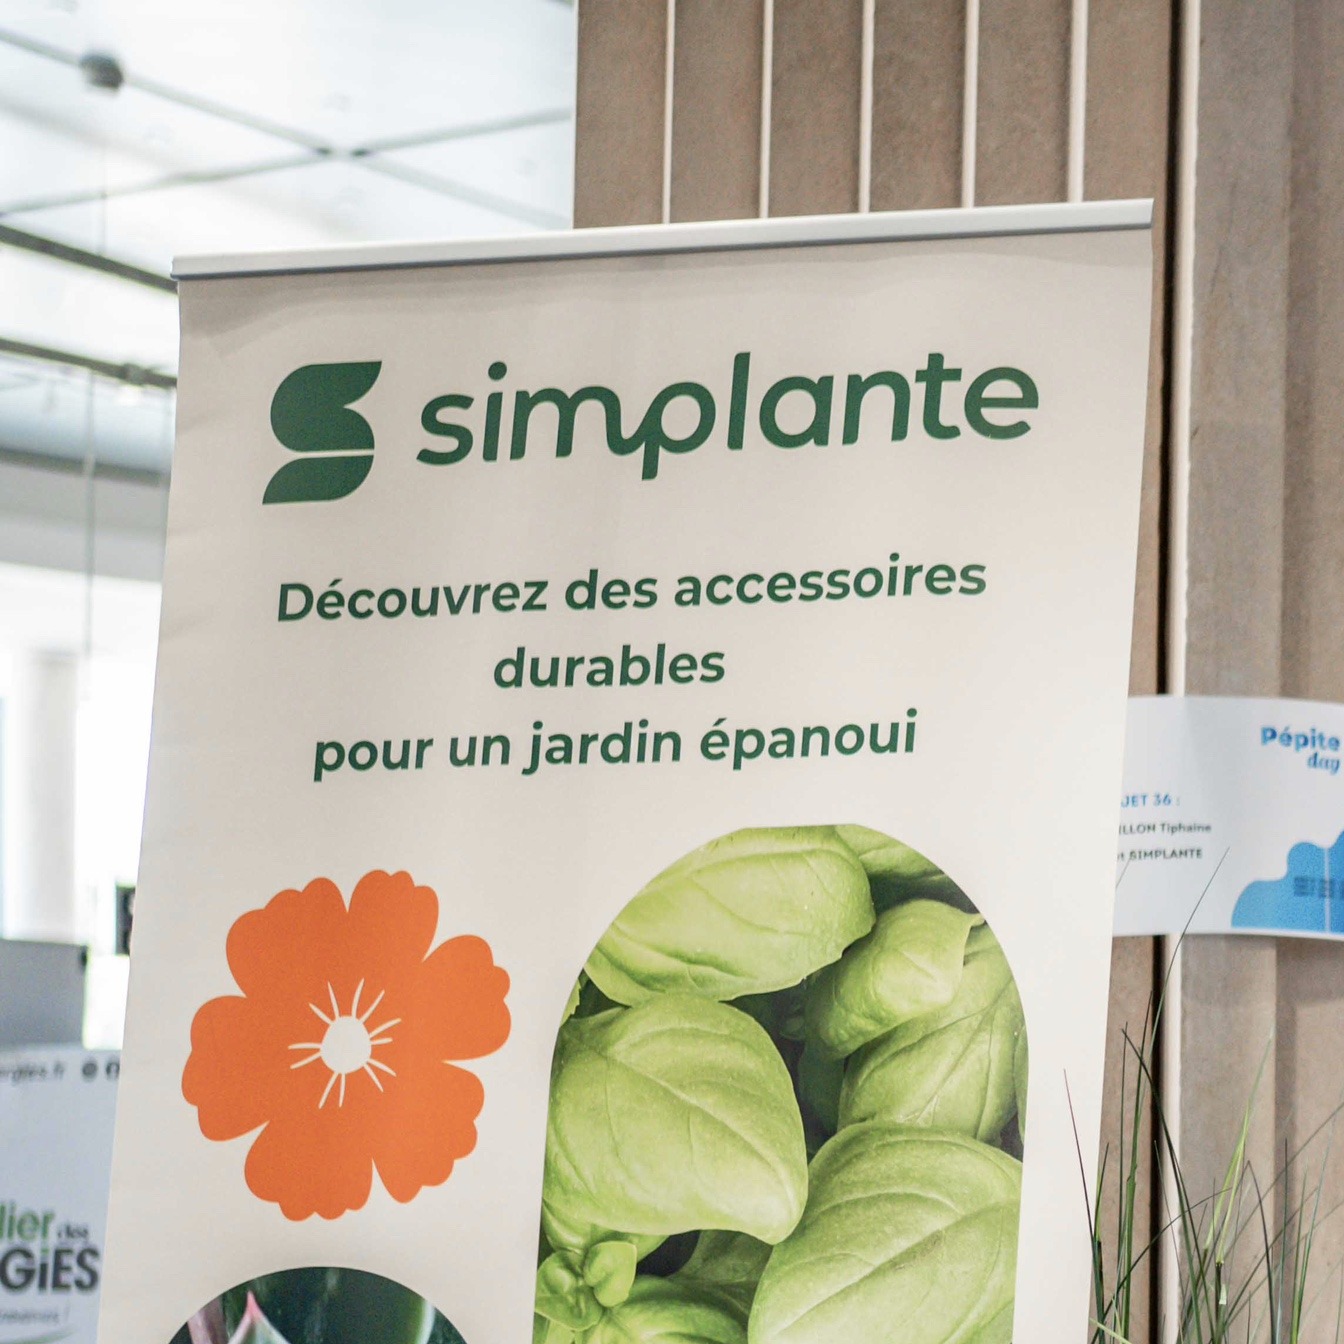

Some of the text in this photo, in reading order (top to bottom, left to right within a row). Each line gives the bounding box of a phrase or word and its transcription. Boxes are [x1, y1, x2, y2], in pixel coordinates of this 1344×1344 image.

[415, 352, 1039, 480] simplante
[277, 551, 987, 622] Découvrez des accessoires
[493, 642, 726, 690] durables
[313, 708, 917, 783] pour un jardin épanoui
[1260, 725, 1340, 752] Pépite
[1307, 750, 1340, 775] day
[1120, 793, 1148, 808] JET
[1119, 821, 1212, 836] ILLON Tiphaine
[1129, 848, 1203, 861] SIMPLANTE
